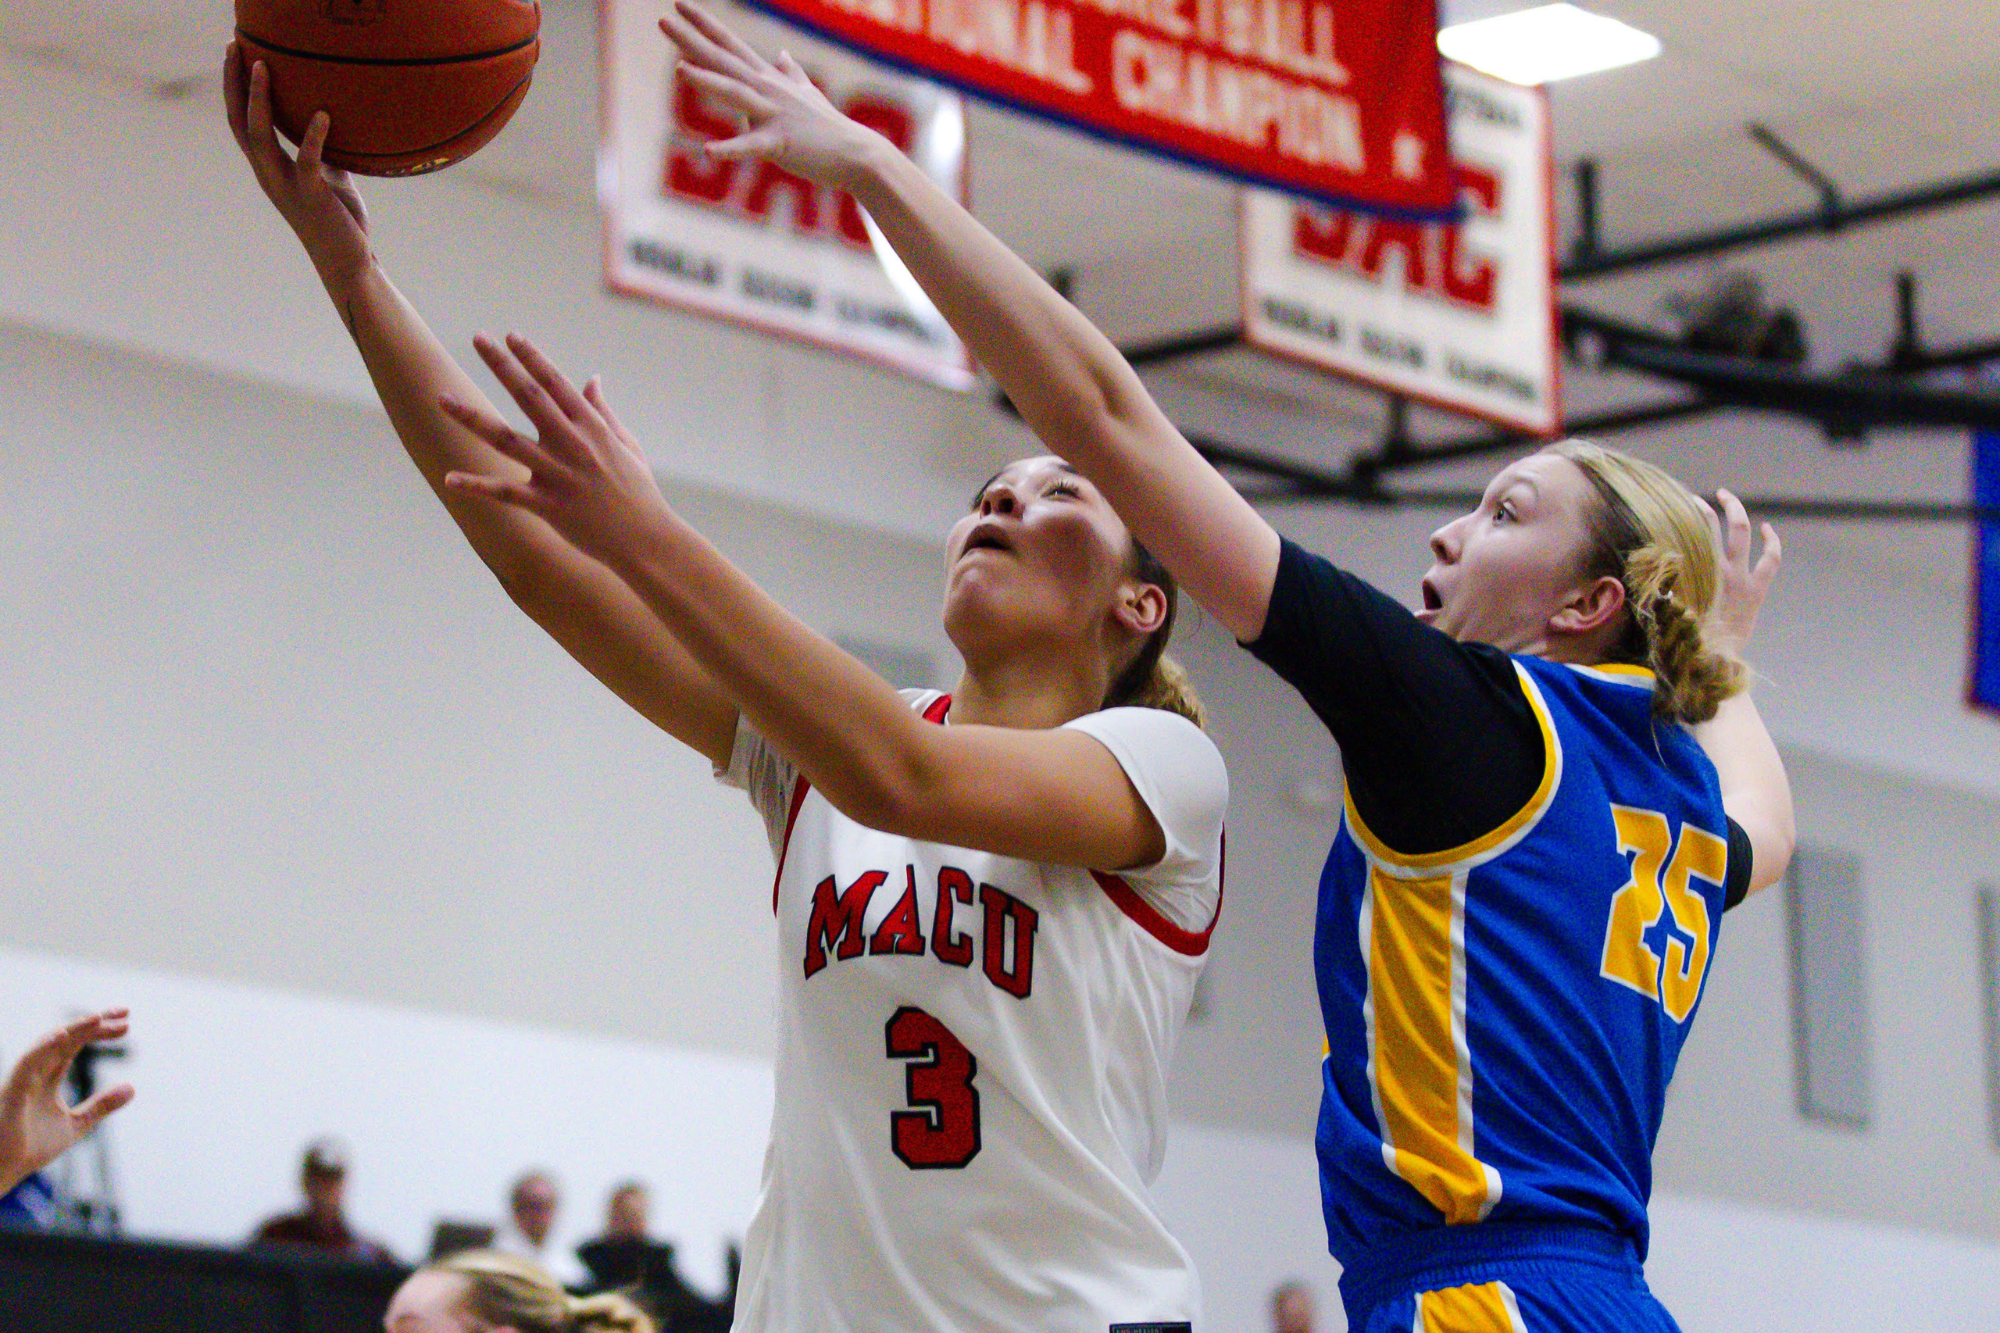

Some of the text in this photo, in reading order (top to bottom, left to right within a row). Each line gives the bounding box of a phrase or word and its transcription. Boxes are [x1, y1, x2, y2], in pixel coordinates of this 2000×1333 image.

[1111, 29, 1367, 174] CHAMPION
[803, 864, 1039, 999] MACU
[1600, 802, 1728, 1024] 25
[885, 1005, 981, 1170] 3
